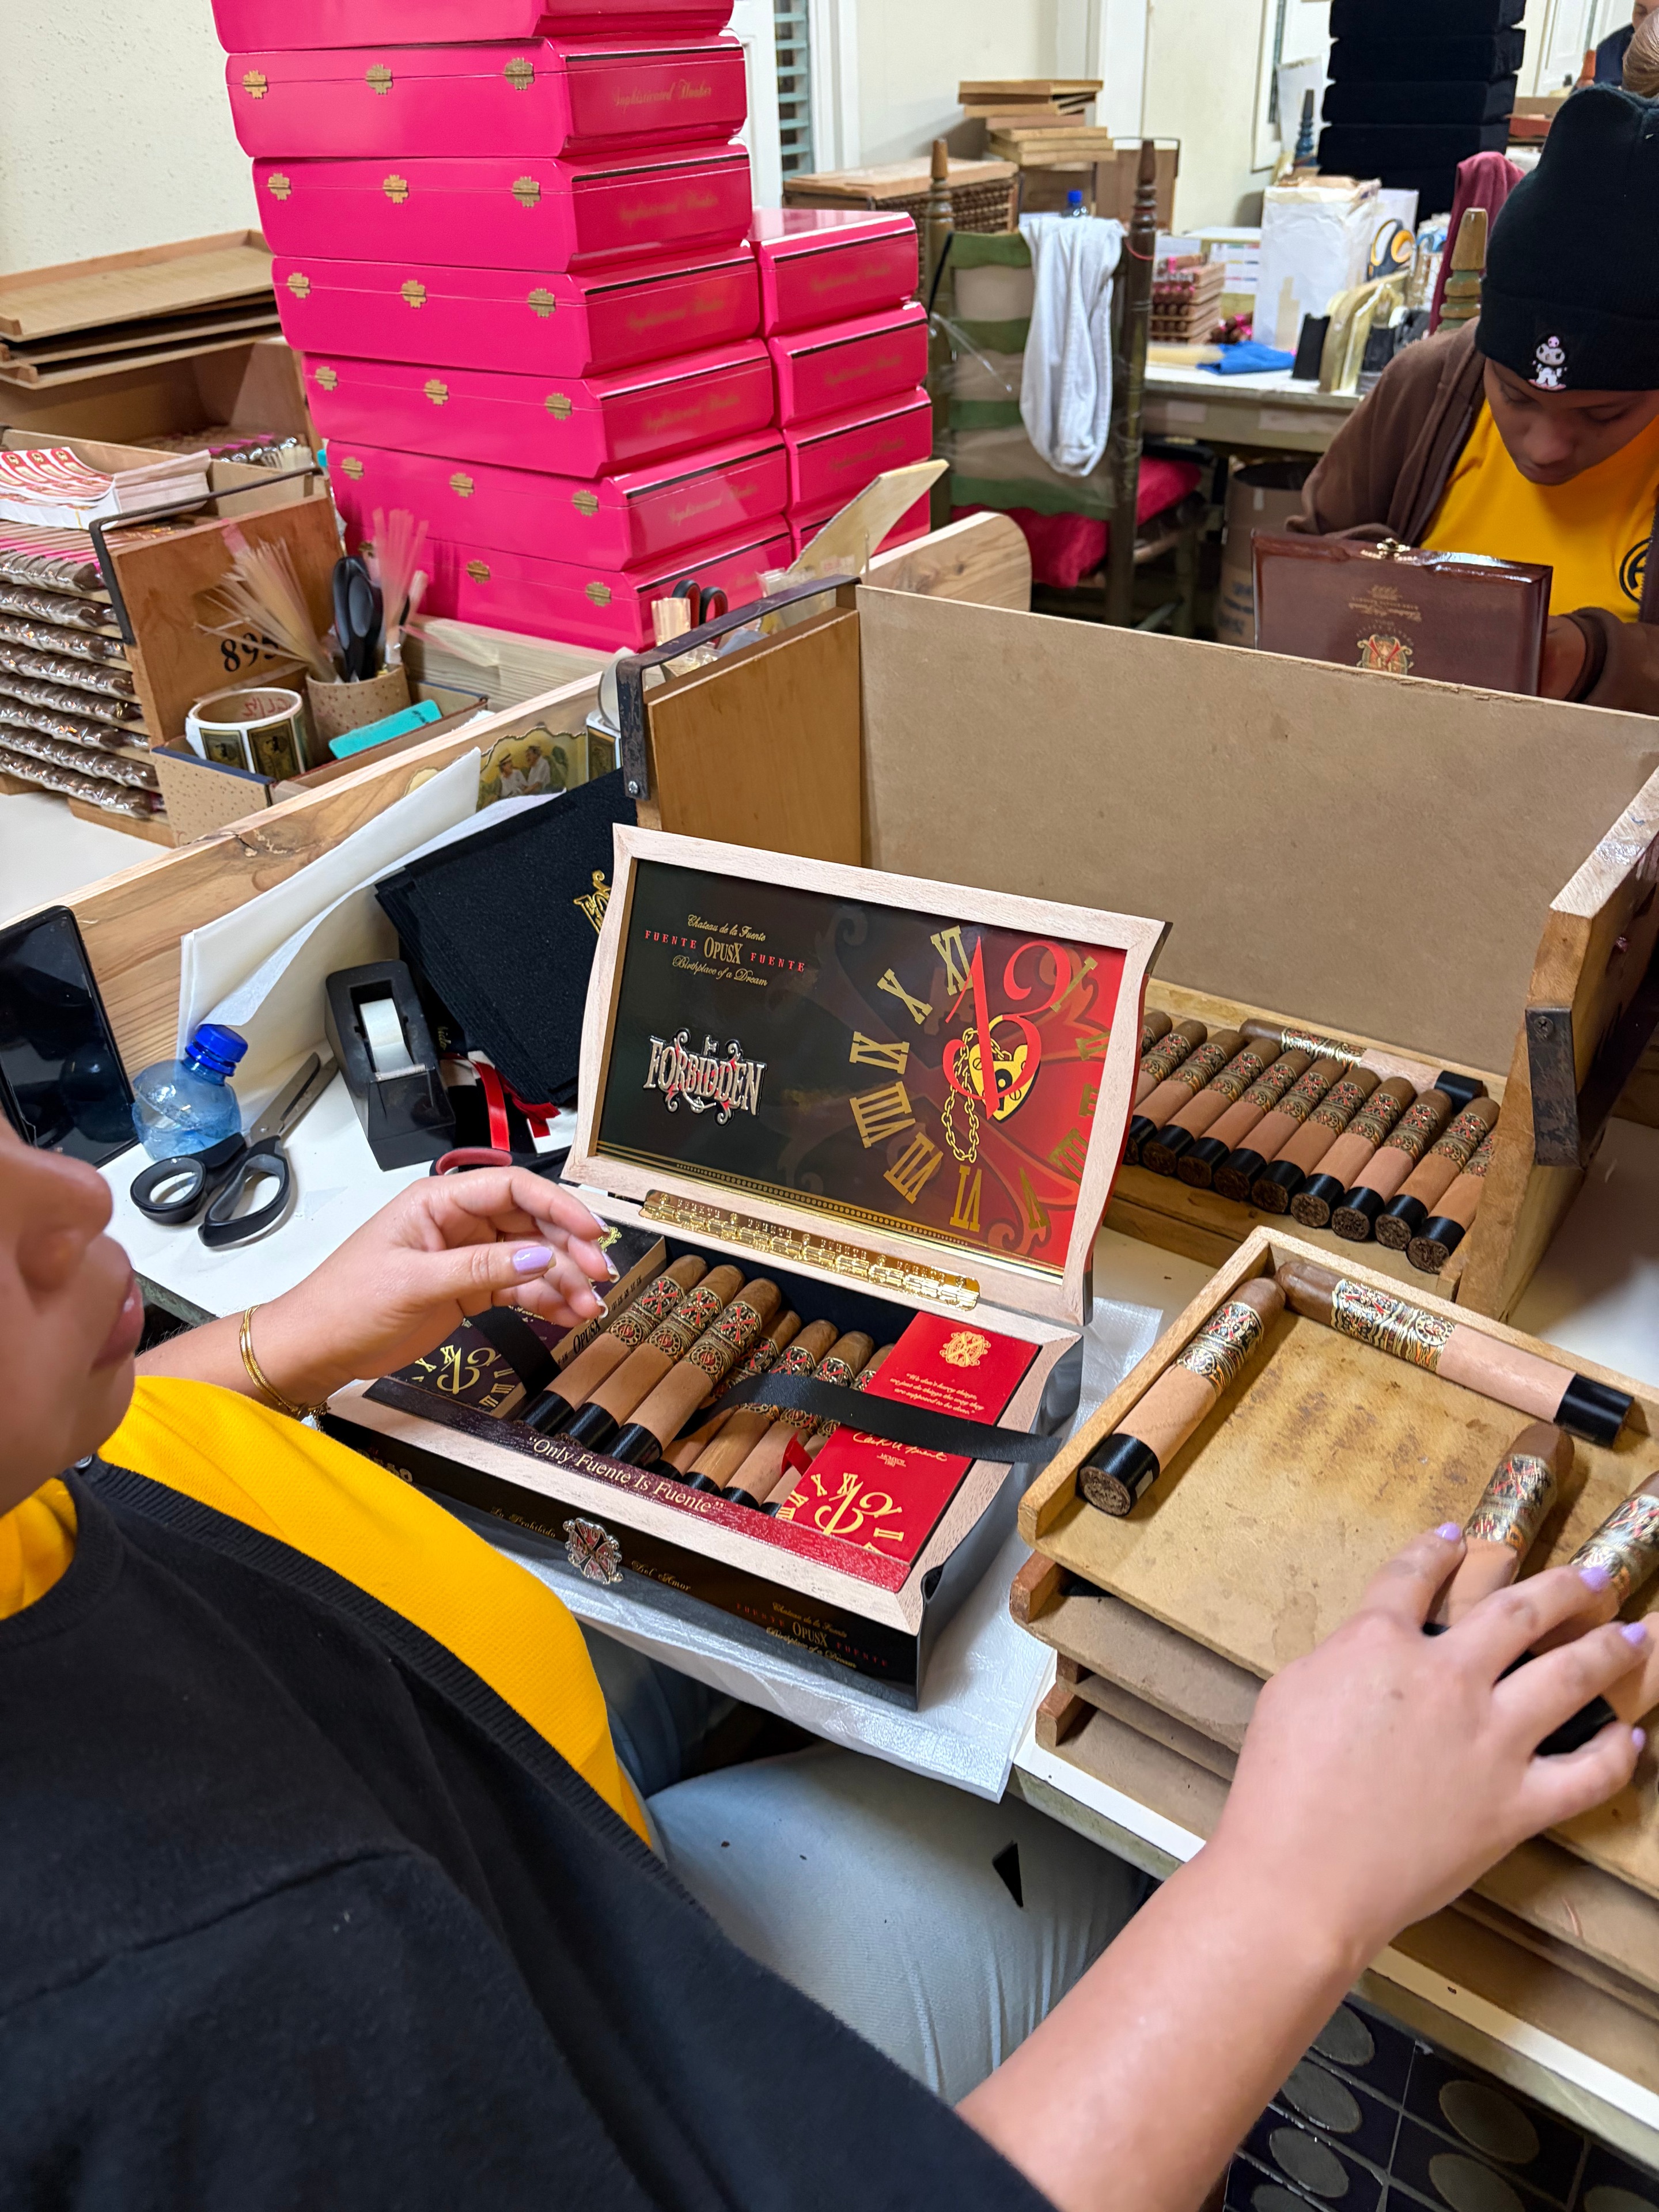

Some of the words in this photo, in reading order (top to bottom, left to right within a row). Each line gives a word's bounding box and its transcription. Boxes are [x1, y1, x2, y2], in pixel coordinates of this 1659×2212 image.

[687, 914, 718, 932] Chateau
[719, 923, 729, 935] de
[729, 924, 737, 936] la
[738, 926, 766, 941] Fuente
[645, 930, 697, 949] FUENTE
[750, 952, 805, 972] FUENTE
[672, 955, 717, 975] Birthplace
[715, 967, 727, 980] of
[734, 968, 768, 987] Dream
[877, 968, 933, 1025] X
[643, 1034, 767, 1116] FORBIDDEN
[575, 1453, 631, 1483] Fuente
[810, 1474, 827, 1497] X
